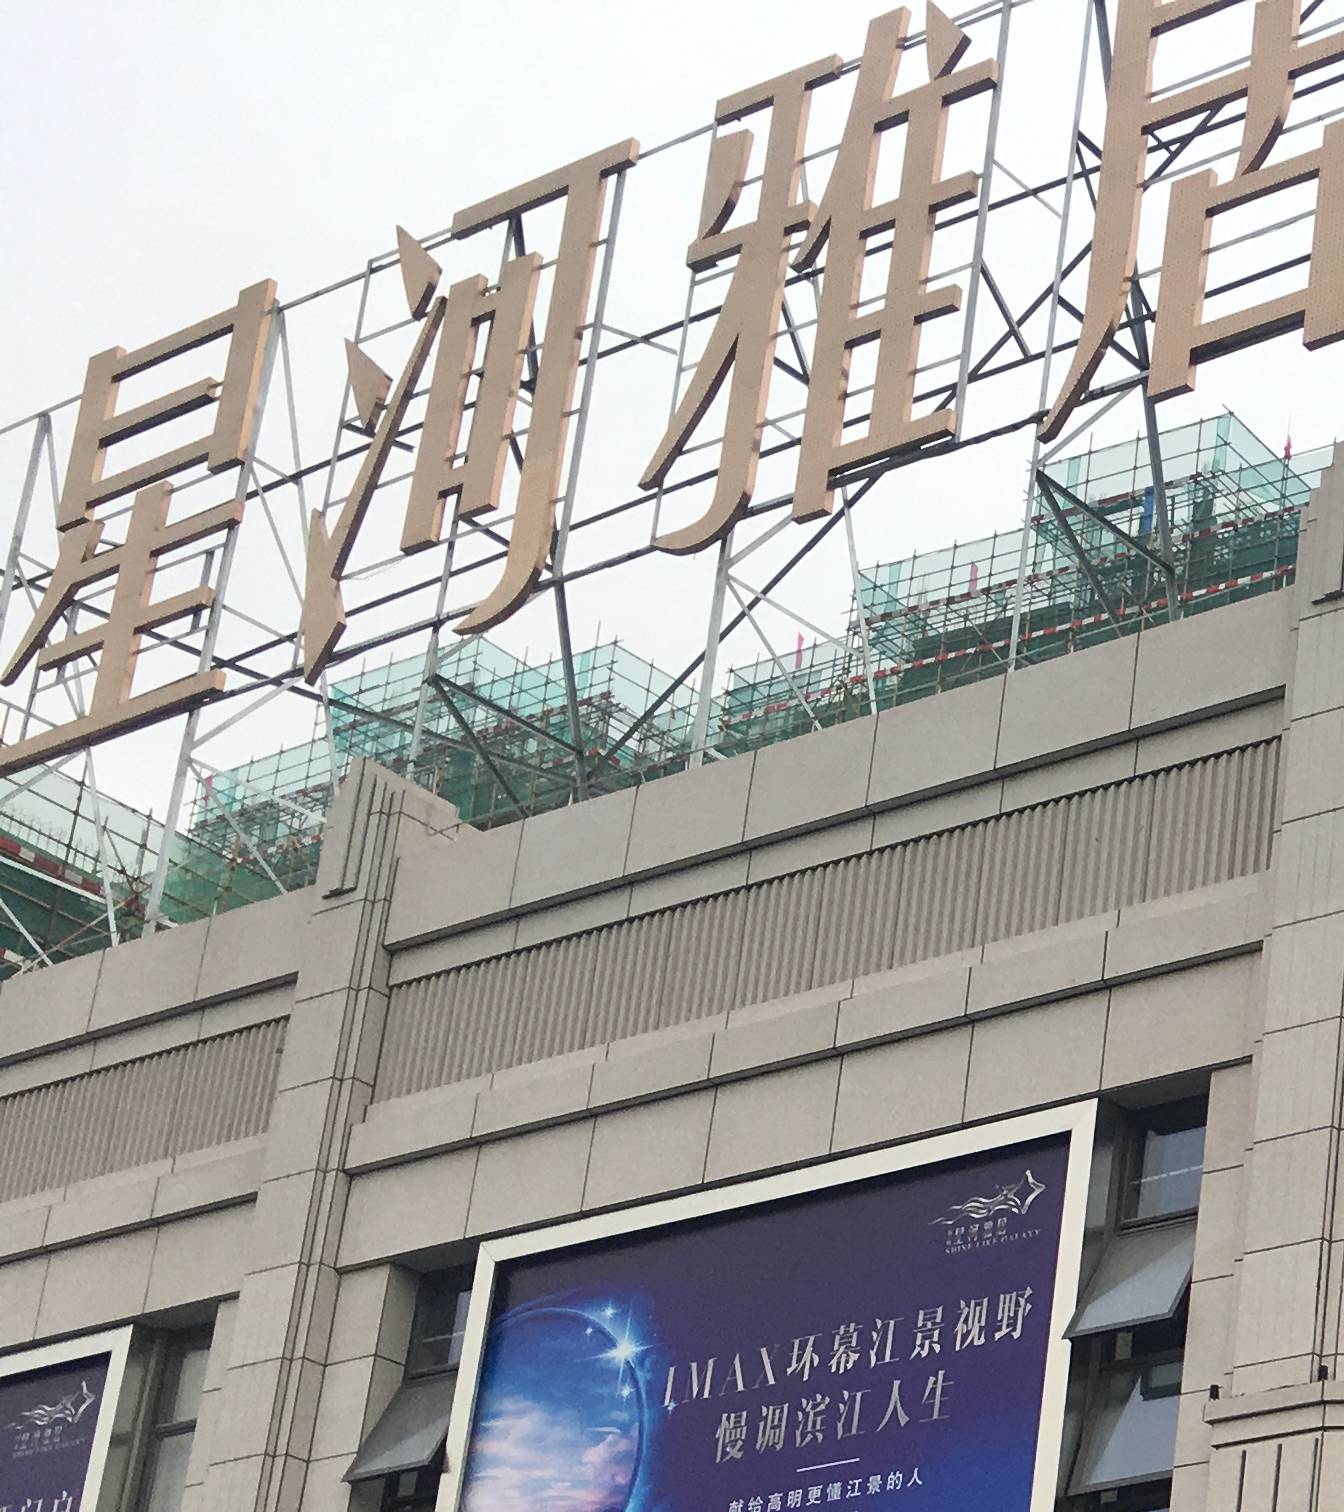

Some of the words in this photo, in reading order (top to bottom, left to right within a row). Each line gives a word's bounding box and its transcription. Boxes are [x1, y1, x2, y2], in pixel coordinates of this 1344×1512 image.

[662, 1286, 1033, 1408] IMAX环幕江景视野
[714, 1369, 954, 1463] 慢调滨江人生
